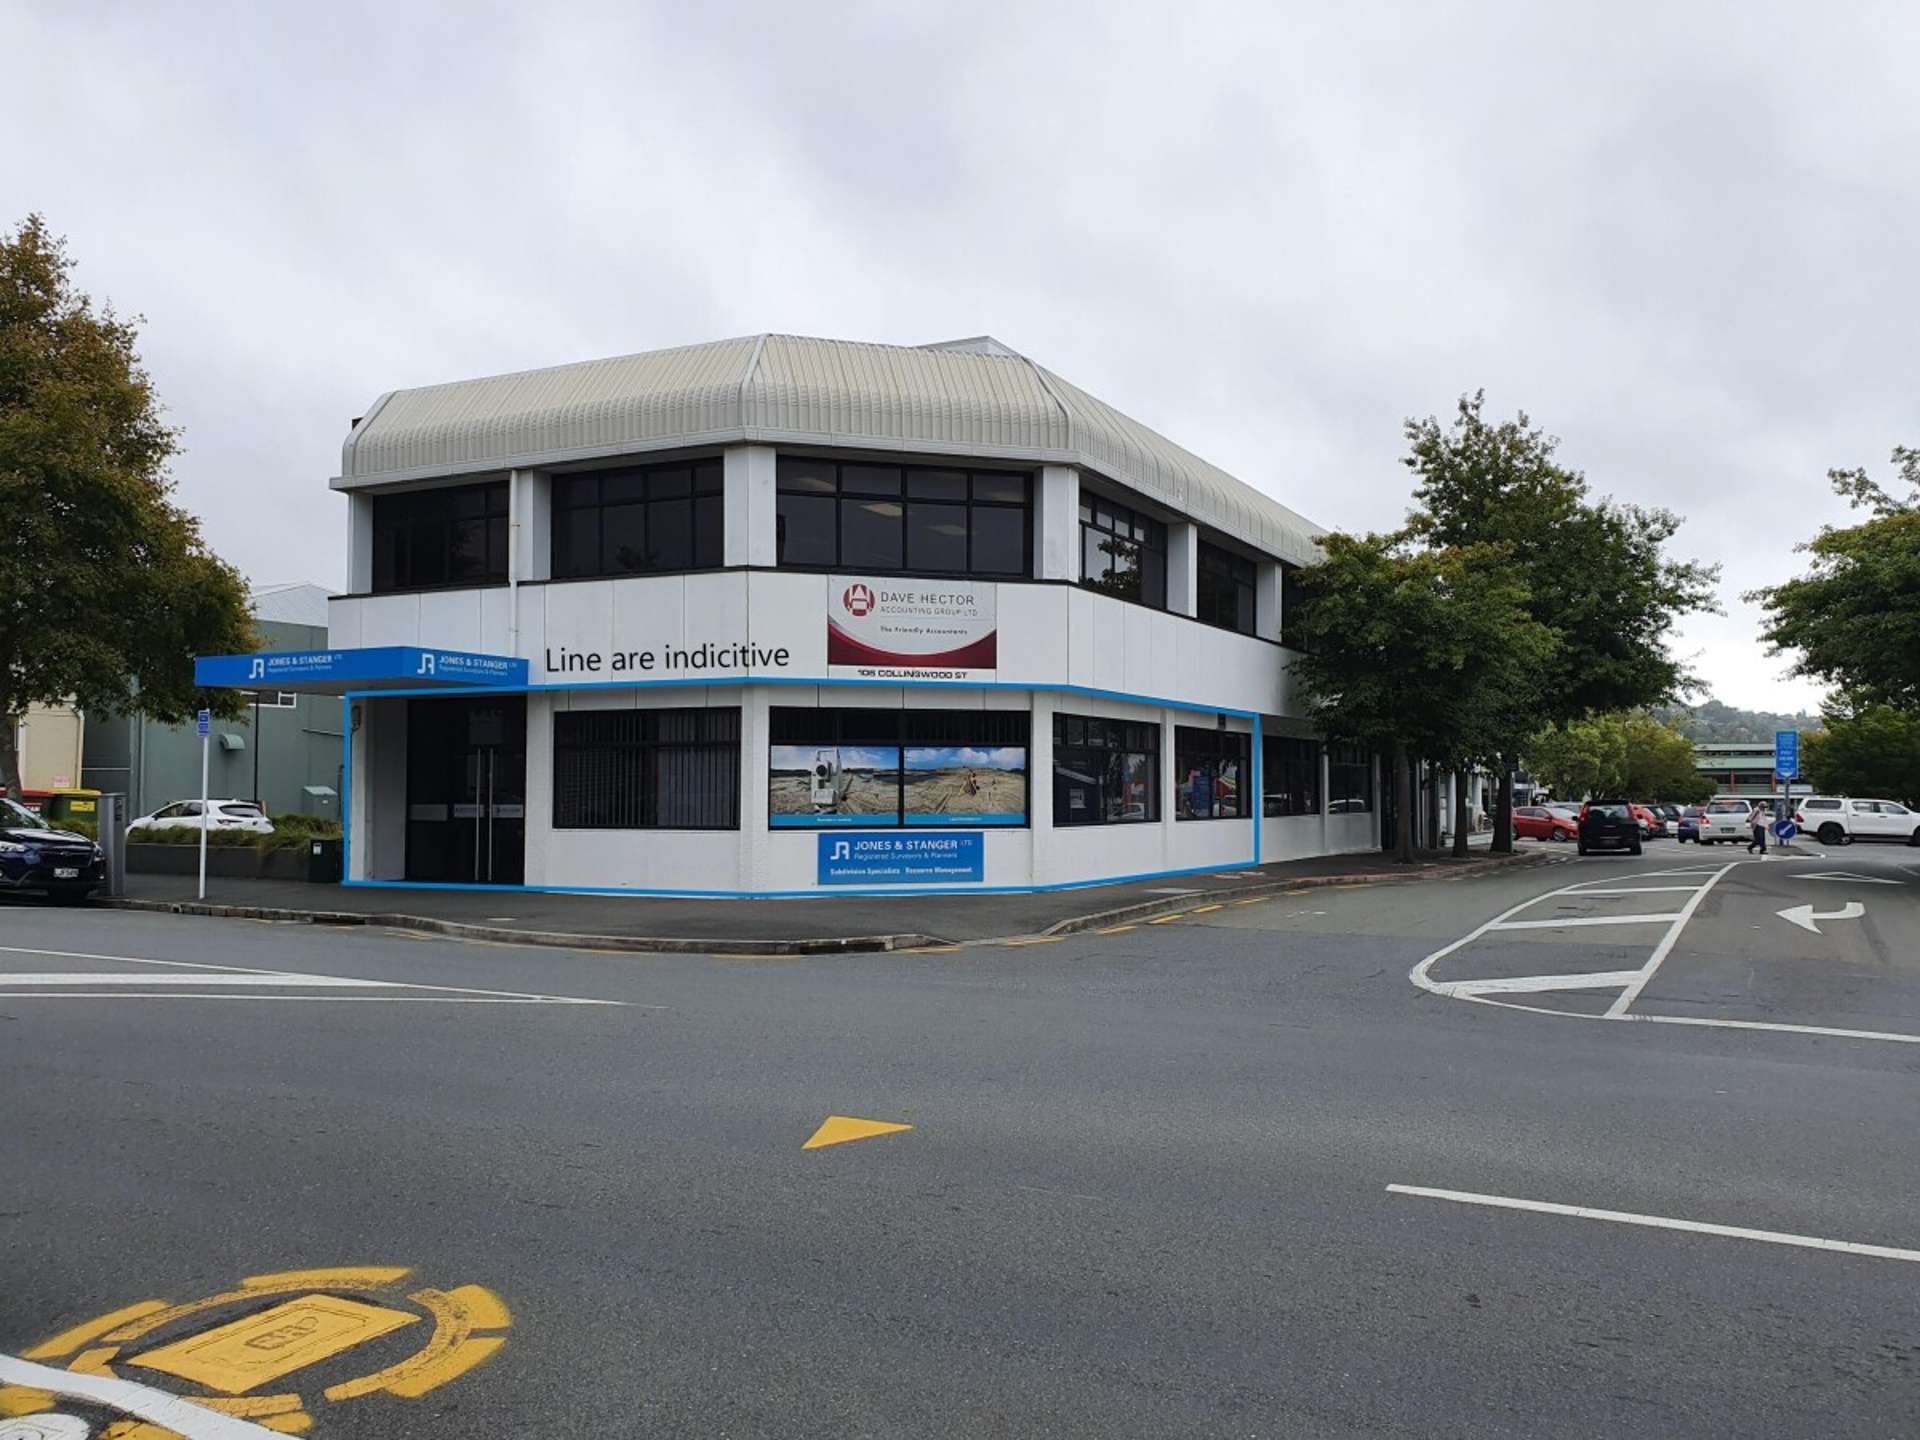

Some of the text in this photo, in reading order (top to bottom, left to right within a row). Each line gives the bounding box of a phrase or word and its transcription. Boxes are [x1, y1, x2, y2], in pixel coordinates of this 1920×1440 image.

[880, 592, 975, 606] DAVE HECTOR
[880, 606, 932, 616] ACCOUNTING
[878, 669, 953, 679] COLLINGWOOD
[954, 671, 968, 679] ST
[854, 840, 892, 851] JONES
[894, 840, 903, 851] &
[906, 839, 958, 850] STANGER
